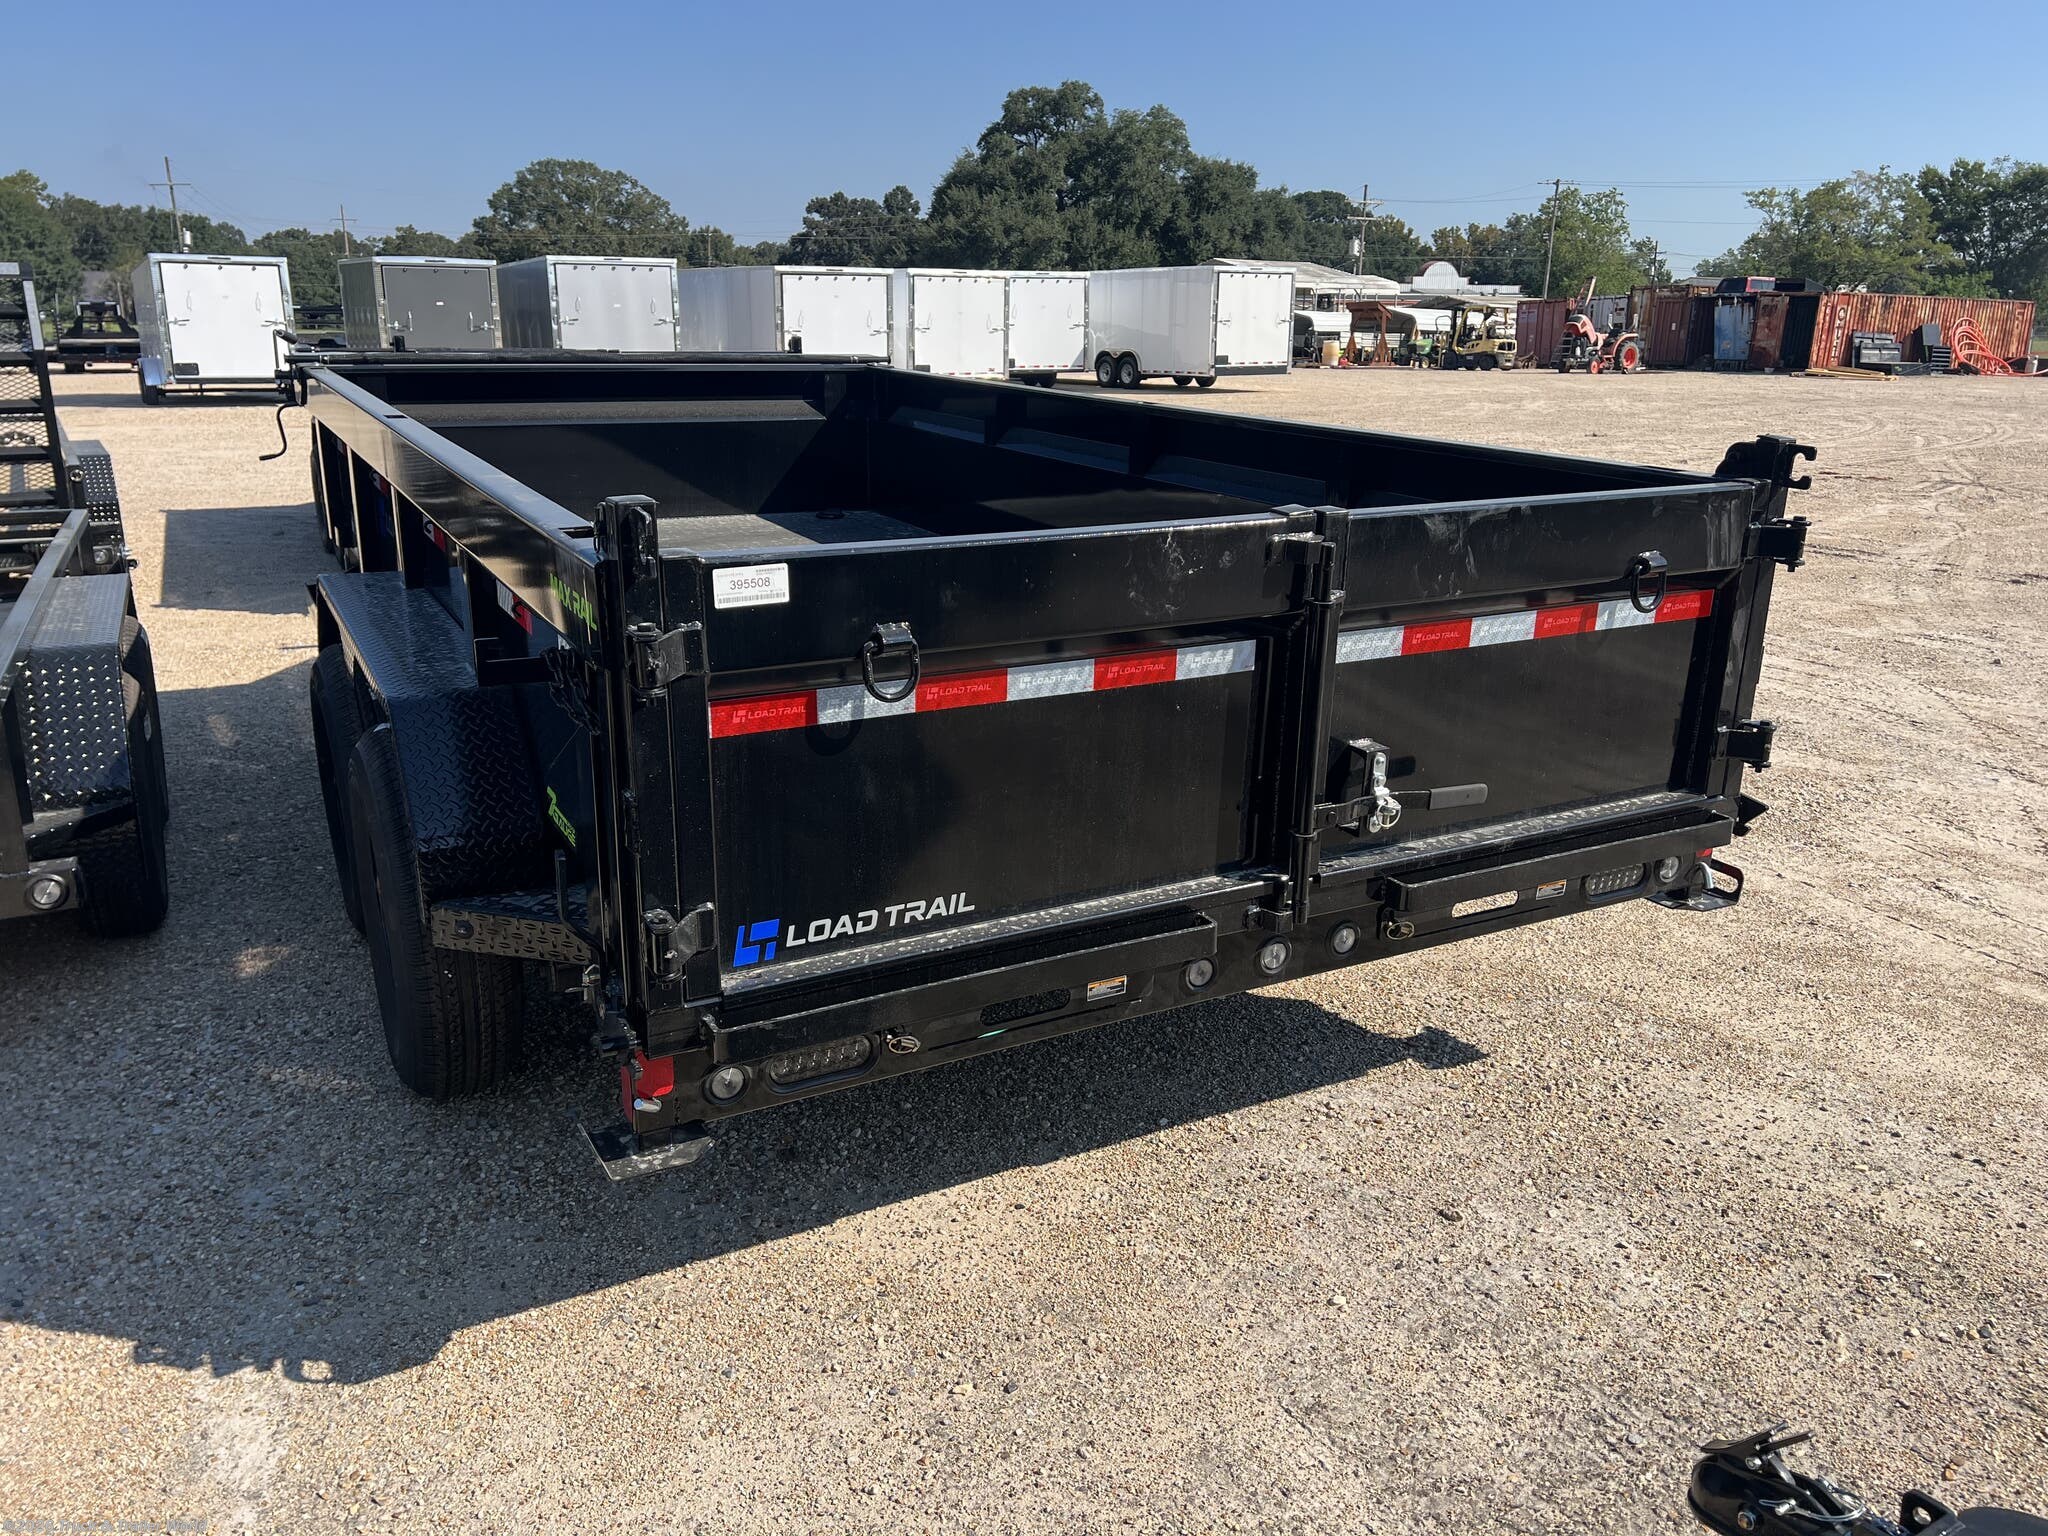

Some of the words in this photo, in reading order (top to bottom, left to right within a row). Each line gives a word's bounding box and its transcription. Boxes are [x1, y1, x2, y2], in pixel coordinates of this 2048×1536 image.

[730, 576, 771, 590] 395508
[550, 573, 572, 611] MAX
[572, 590, 597, 631] RAIL
[1421, 633, 1440, 641] LOAD
[1440, 631, 1460, 640] TRAIL
[1119, 665, 1144, 675] LOAD
[1143, 662, 1167, 672] TRAIL
[939, 686, 966, 697] LOAD
[966, 683, 992, 693] TRAIL
[747, 705, 777, 715] LOAD
[777, 700, 807, 711] TRAIL
[785, 909, 879, 948] LOAD
[884, 892, 976, 926] TRAIL
